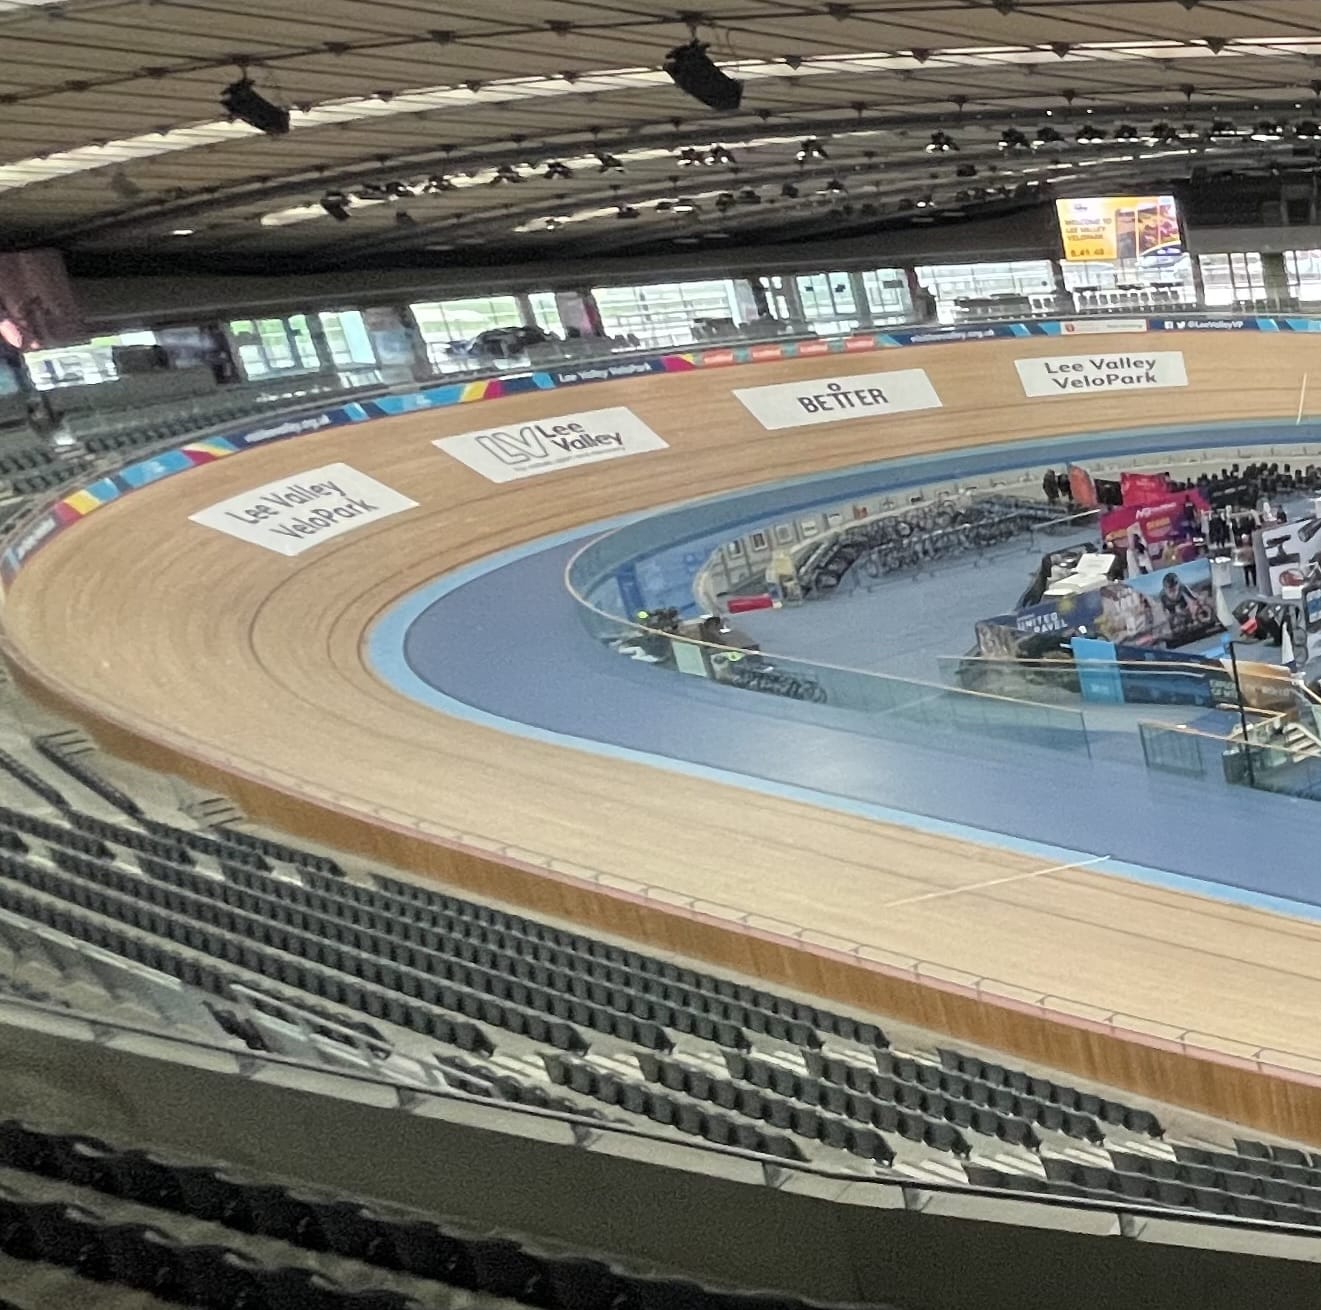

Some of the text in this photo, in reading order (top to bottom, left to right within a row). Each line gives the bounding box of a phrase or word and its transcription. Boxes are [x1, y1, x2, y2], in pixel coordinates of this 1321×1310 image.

[1044, 357, 1157, 374] Lee Valley
[1052, 371, 1158, 389] VeloPark
[797, 385, 889, 414] BETTER
[535, 422, 586, 438] Lee
[551, 432, 624, 452] Valley
[224, 480, 347, 524] Lee Valley
[269, 497, 380, 540] VeloPark
